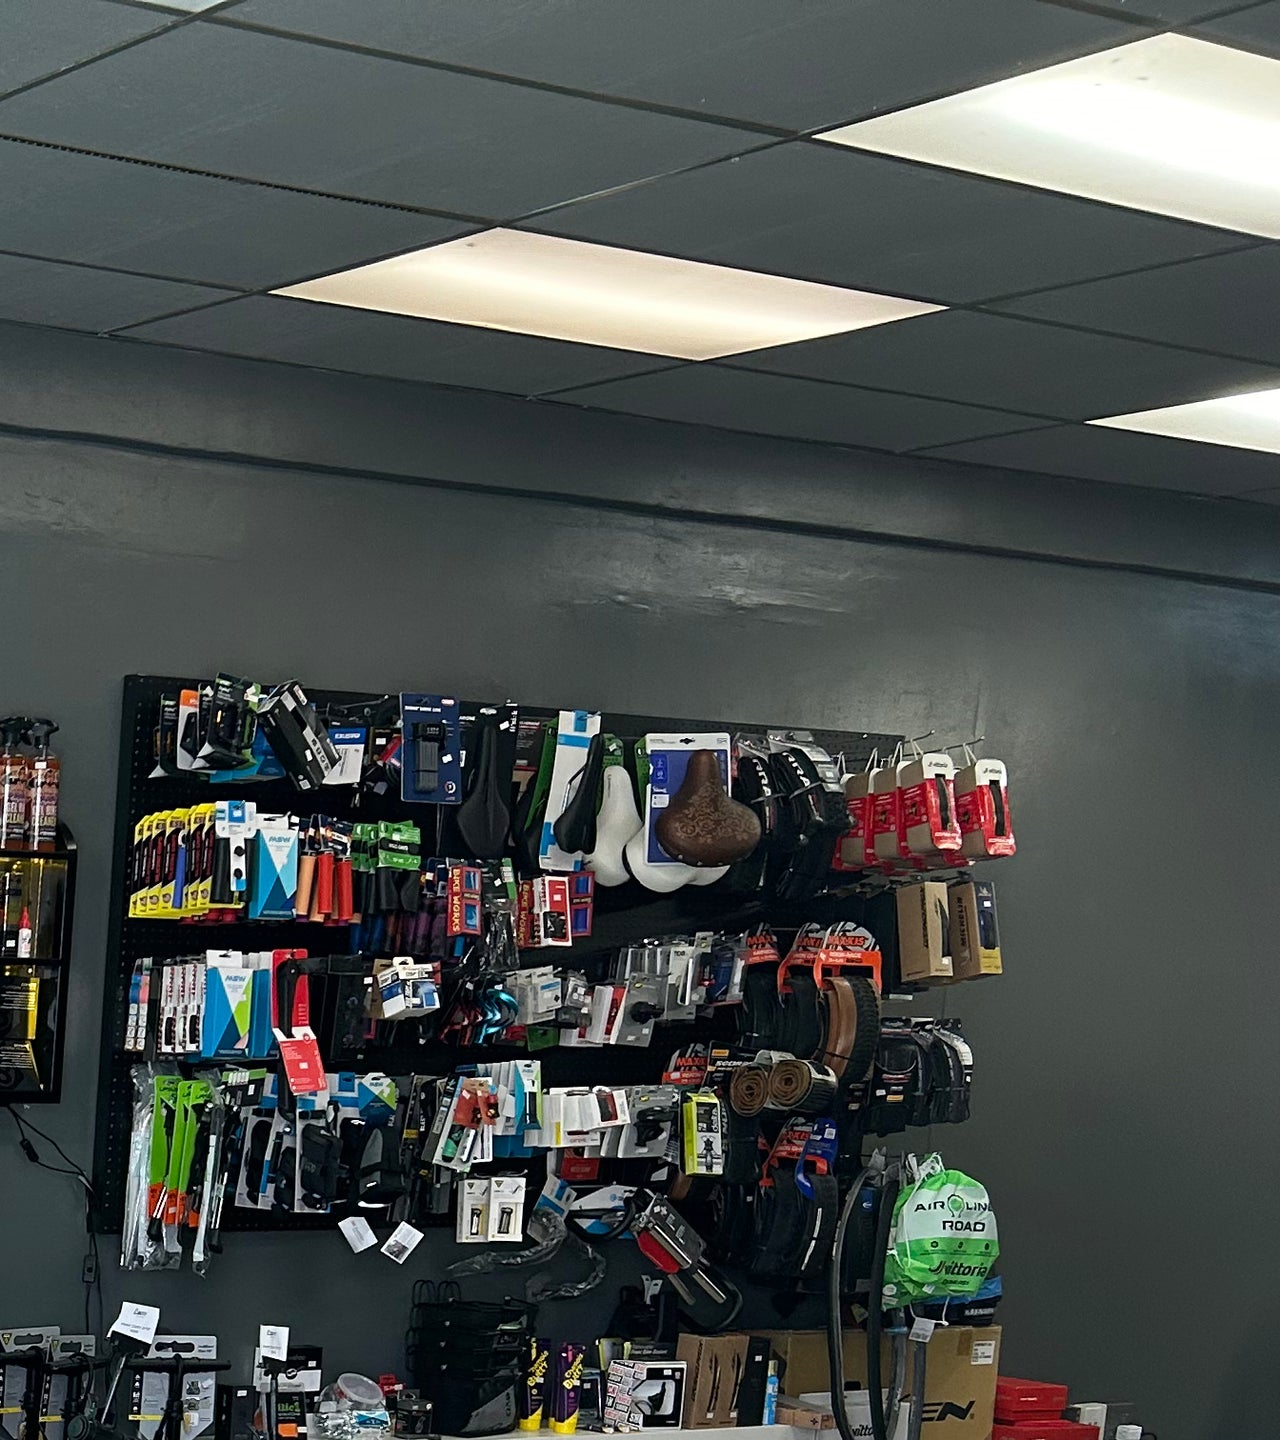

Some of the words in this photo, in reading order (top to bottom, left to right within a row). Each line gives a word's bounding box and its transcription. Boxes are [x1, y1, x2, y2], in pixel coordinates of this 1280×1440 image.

[452, 868, 460, 894] BIKE
[451, 895, 461, 932] WORKS
[914, 1200, 946, 1213] AIR
[942, 1220, 986, 1232] ROAD
[852, 1424, 874, 1437] vitto
